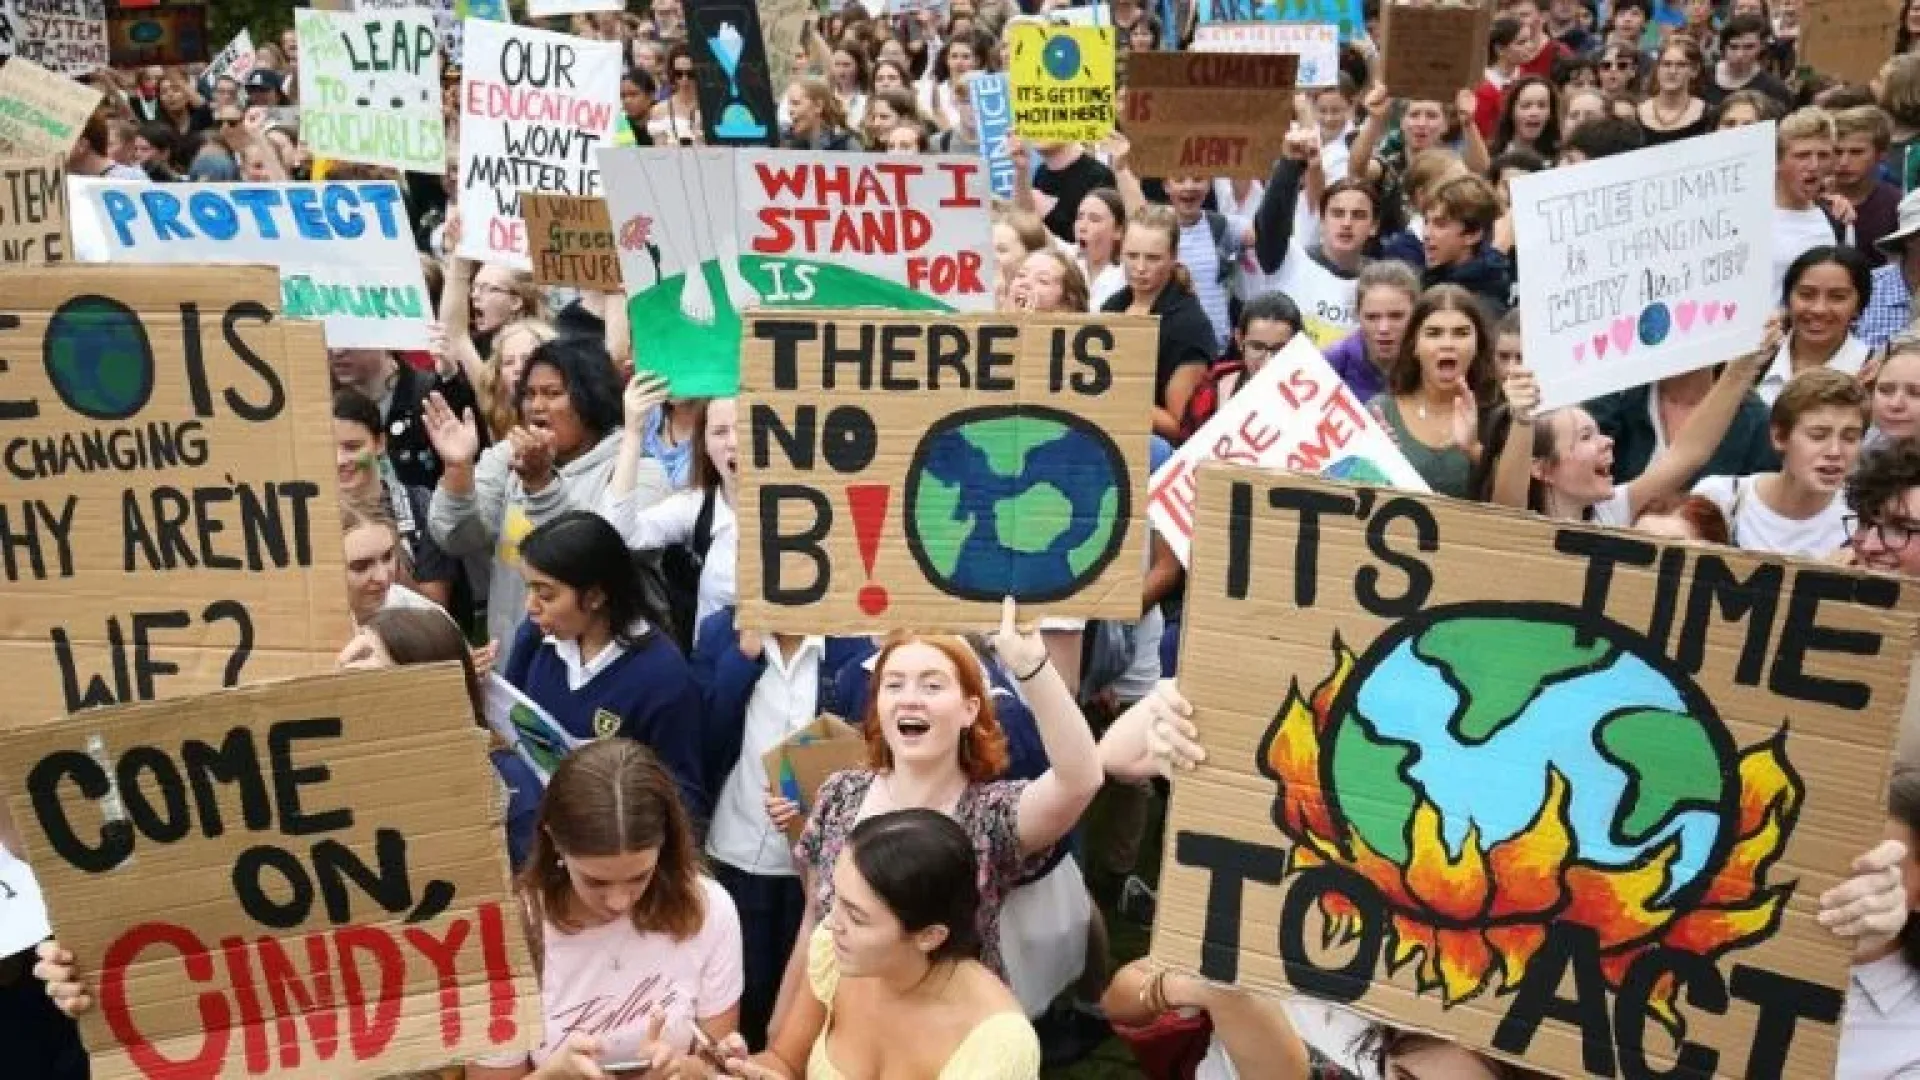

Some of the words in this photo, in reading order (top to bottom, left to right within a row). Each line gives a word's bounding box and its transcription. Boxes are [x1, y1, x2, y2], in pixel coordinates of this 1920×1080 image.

[340, 19, 436, 75] LEAP
[500, 37, 577, 88] OUR
[314, 76, 348, 108] TO
[467, 80, 612, 131] EDUCATION
[1048, 84, 1111, 104] GETTING
[1127, 91, 1152, 121] IS
[0, 167, 63, 225] TEM
[465, 155, 571, 195] MATTER
[754, 162, 923, 207] WHAT
[937, 162, 981, 208] I
[1537, 180, 1634, 243] THE
[1642, 161, 1748, 217] CLIMATE
[102, 184, 399, 247] PROTECT
[752, 207, 933, 255] STAND
[760, 262, 820, 301] IS
[906, 250, 986, 294] FOR
[180, 301, 287, 422] IS
[754, 320, 1019, 391] THERE
[1049, 325, 1116, 396] IS
[1277, 369, 1319, 411] IS
[4, 421, 209, 480] CHANGING
[750, 404, 878, 473] NO
[0, 494, 78, 581] HY
[759, 484, 890, 617] B!
[1227, 481, 1440, 618] IT'S
[1554, 528, 1902, 710] TIME
[26, 717, 354, 874] COME
[232, 827, 456, 929] ON,
[1176, 831, 1390, 1004] TO
[1493, 920, 1846, 1080] ACT
[102, 902, 518, 1080] CINDY!
